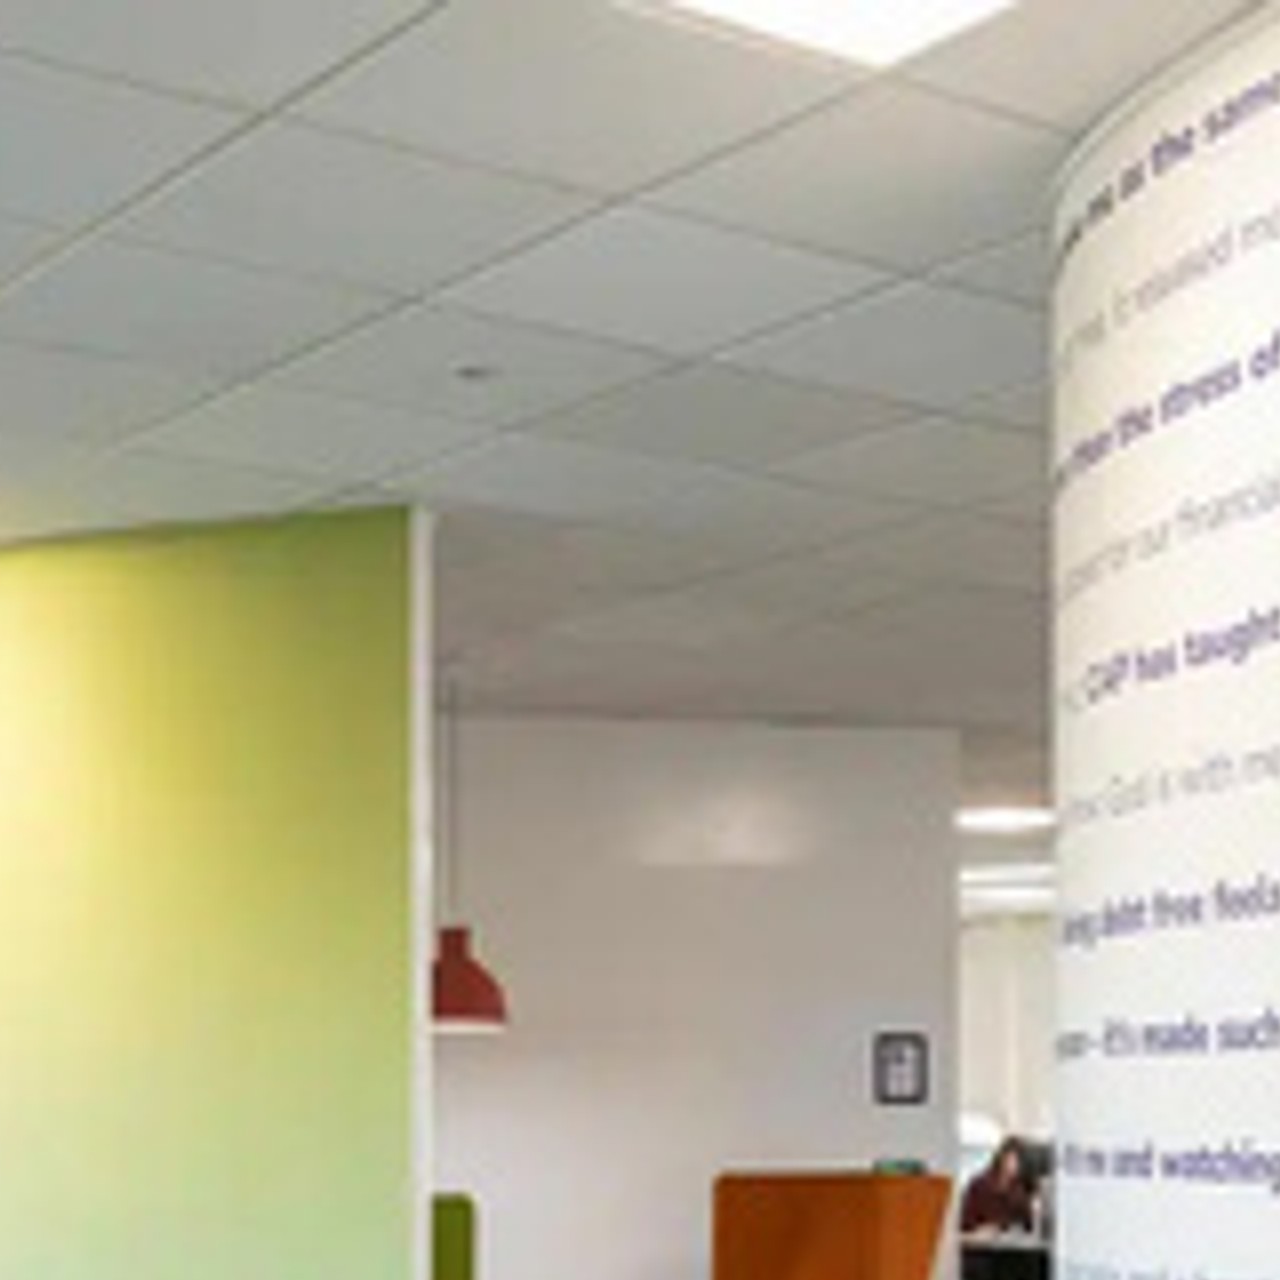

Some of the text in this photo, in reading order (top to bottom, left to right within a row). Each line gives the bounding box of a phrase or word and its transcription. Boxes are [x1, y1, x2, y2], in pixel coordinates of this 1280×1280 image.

[1150, 125, 1195, 177] the
[1159, 358, 1242, 424] stress
[1153, 888, 1203, 928] free
[1143, 1010, 1208, 1055] made
[1113, 1138, 1153, 1178] and
